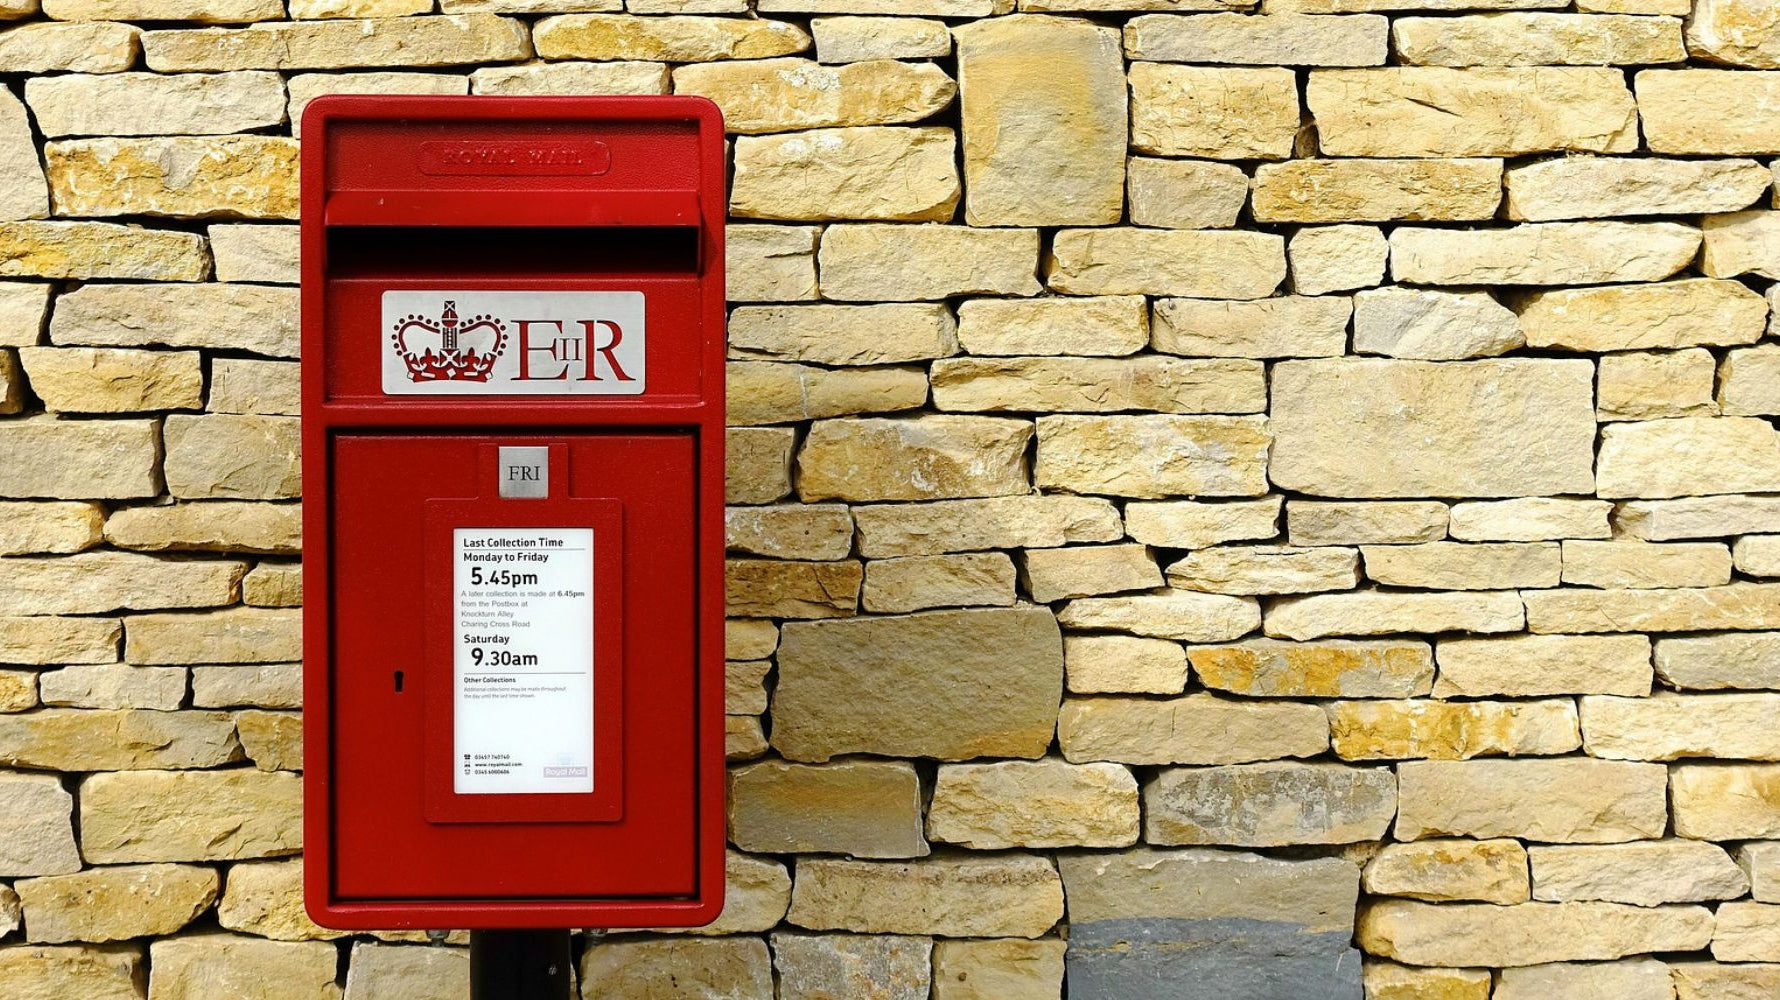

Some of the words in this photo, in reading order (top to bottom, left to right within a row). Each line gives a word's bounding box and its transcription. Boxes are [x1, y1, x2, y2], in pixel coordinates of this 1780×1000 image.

[443, 149, 517, 164] ROYAL
[528, 149, 582, 164] MAIL
[508, 466, 540, 481] FRI
[463, 538, 485, 548] Last
[487, 537, 536, 548] Collection
[538, 537, 564, 547] Time
[463, 552, 503, 563] Monday
[505, 553, 515, 562] to
[517, 552, 549, 563] Friday
[471, 566, 538, 588] 5.45pm
[468, 590, 484, 598] later
[557, 590, 585, 599] 6.45pm
[461, 600, 477, 608] from
[497, 611, 514, 619] Alley
[461, 621, 488, 629] Charing
[463, 634, 510, 645] Saturday
[471, 647, 538, 666] 9.30am
[545, 768, 567, 777] Royal
[568, 768, 586, 776] Mail
